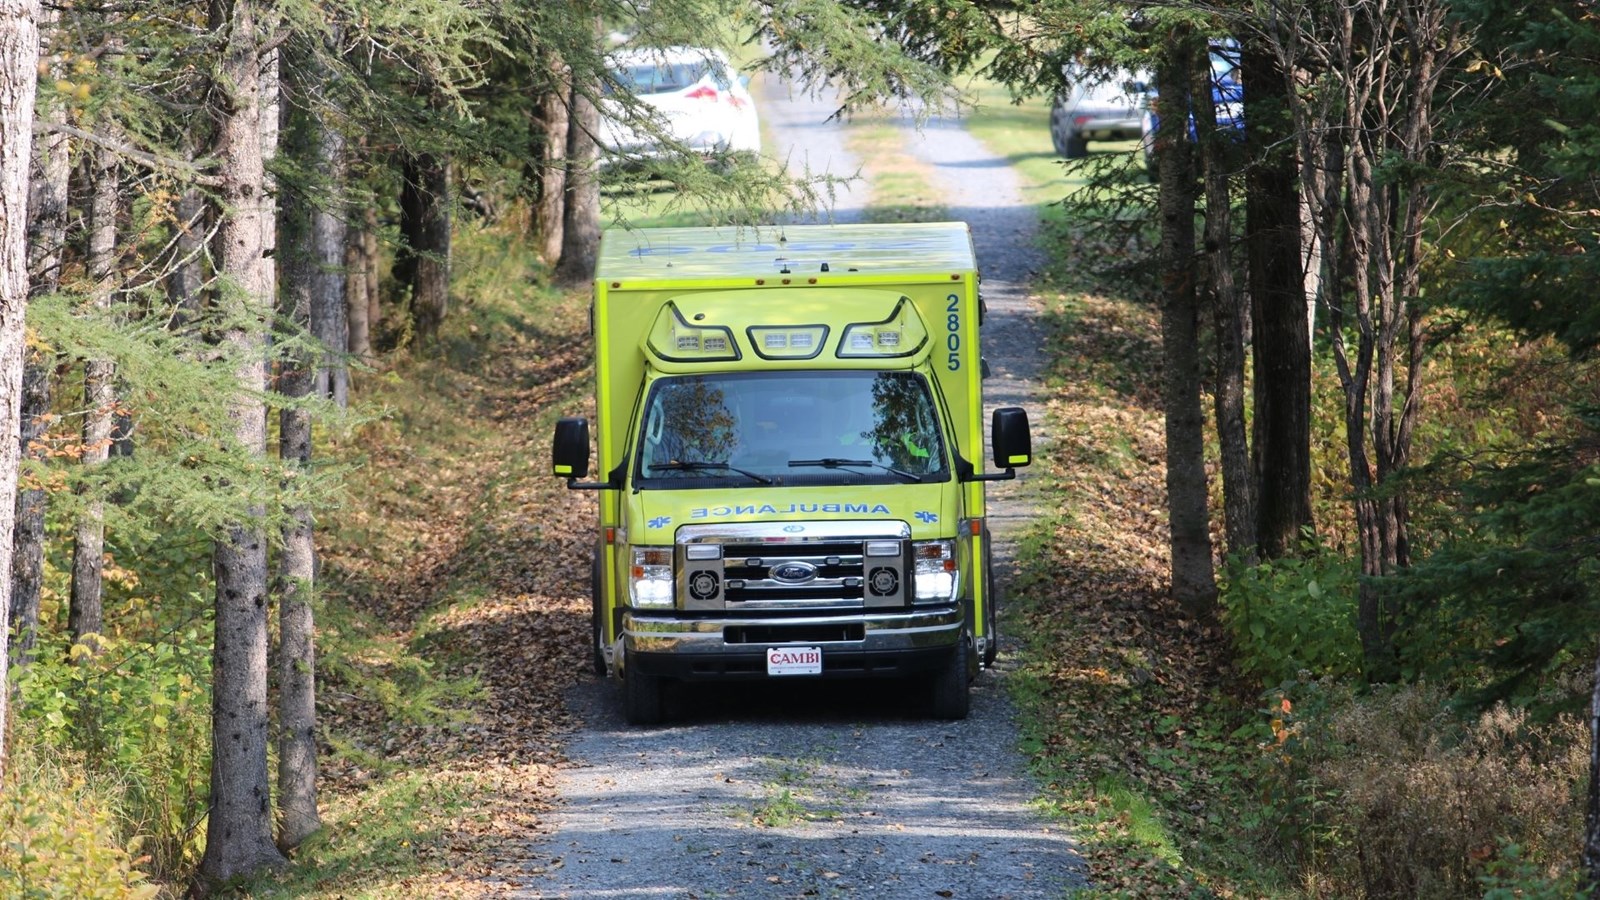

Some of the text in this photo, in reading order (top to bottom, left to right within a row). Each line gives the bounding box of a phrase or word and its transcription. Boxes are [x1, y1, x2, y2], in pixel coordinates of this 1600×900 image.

[946, 294, 960, 371] 2805
[783, 567, 805, 577] Ford
[770, 652, 819, 665] CAMBI
